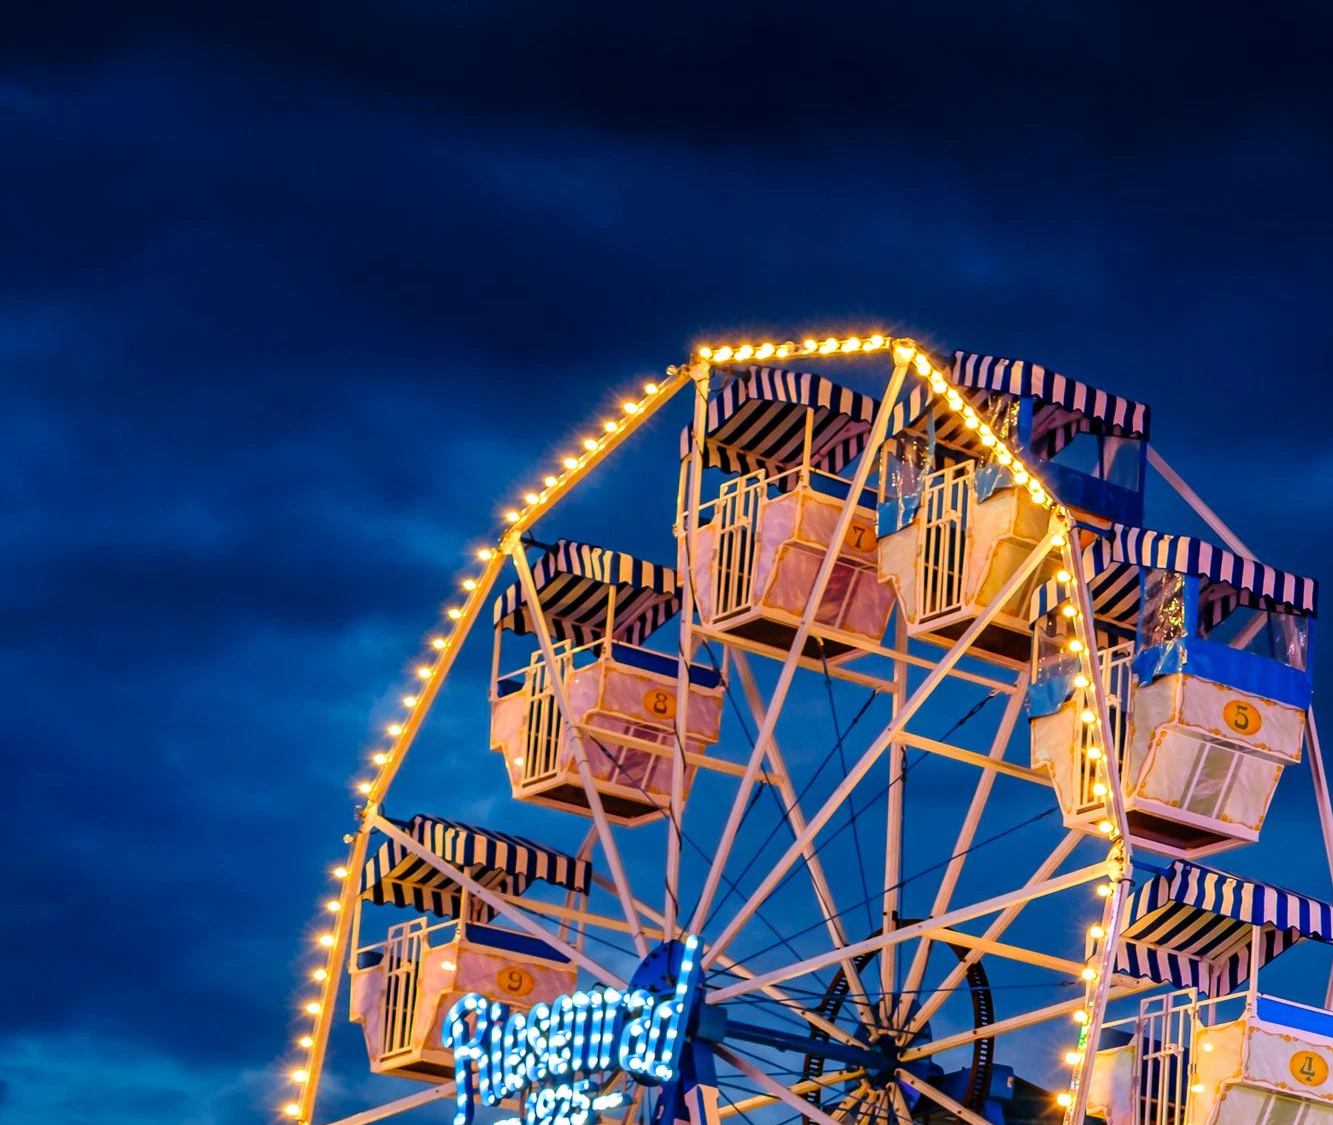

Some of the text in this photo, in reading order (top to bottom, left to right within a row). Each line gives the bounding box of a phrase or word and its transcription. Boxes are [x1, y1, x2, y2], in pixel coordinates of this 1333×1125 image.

[853, 525, 866, 549] 7
[654, 692, 668, 715] 8
[1234, 704, 1249, 730] 5
[507, 970, 523, 992] 9
[1299, 1055, 1316, 1082] 4
